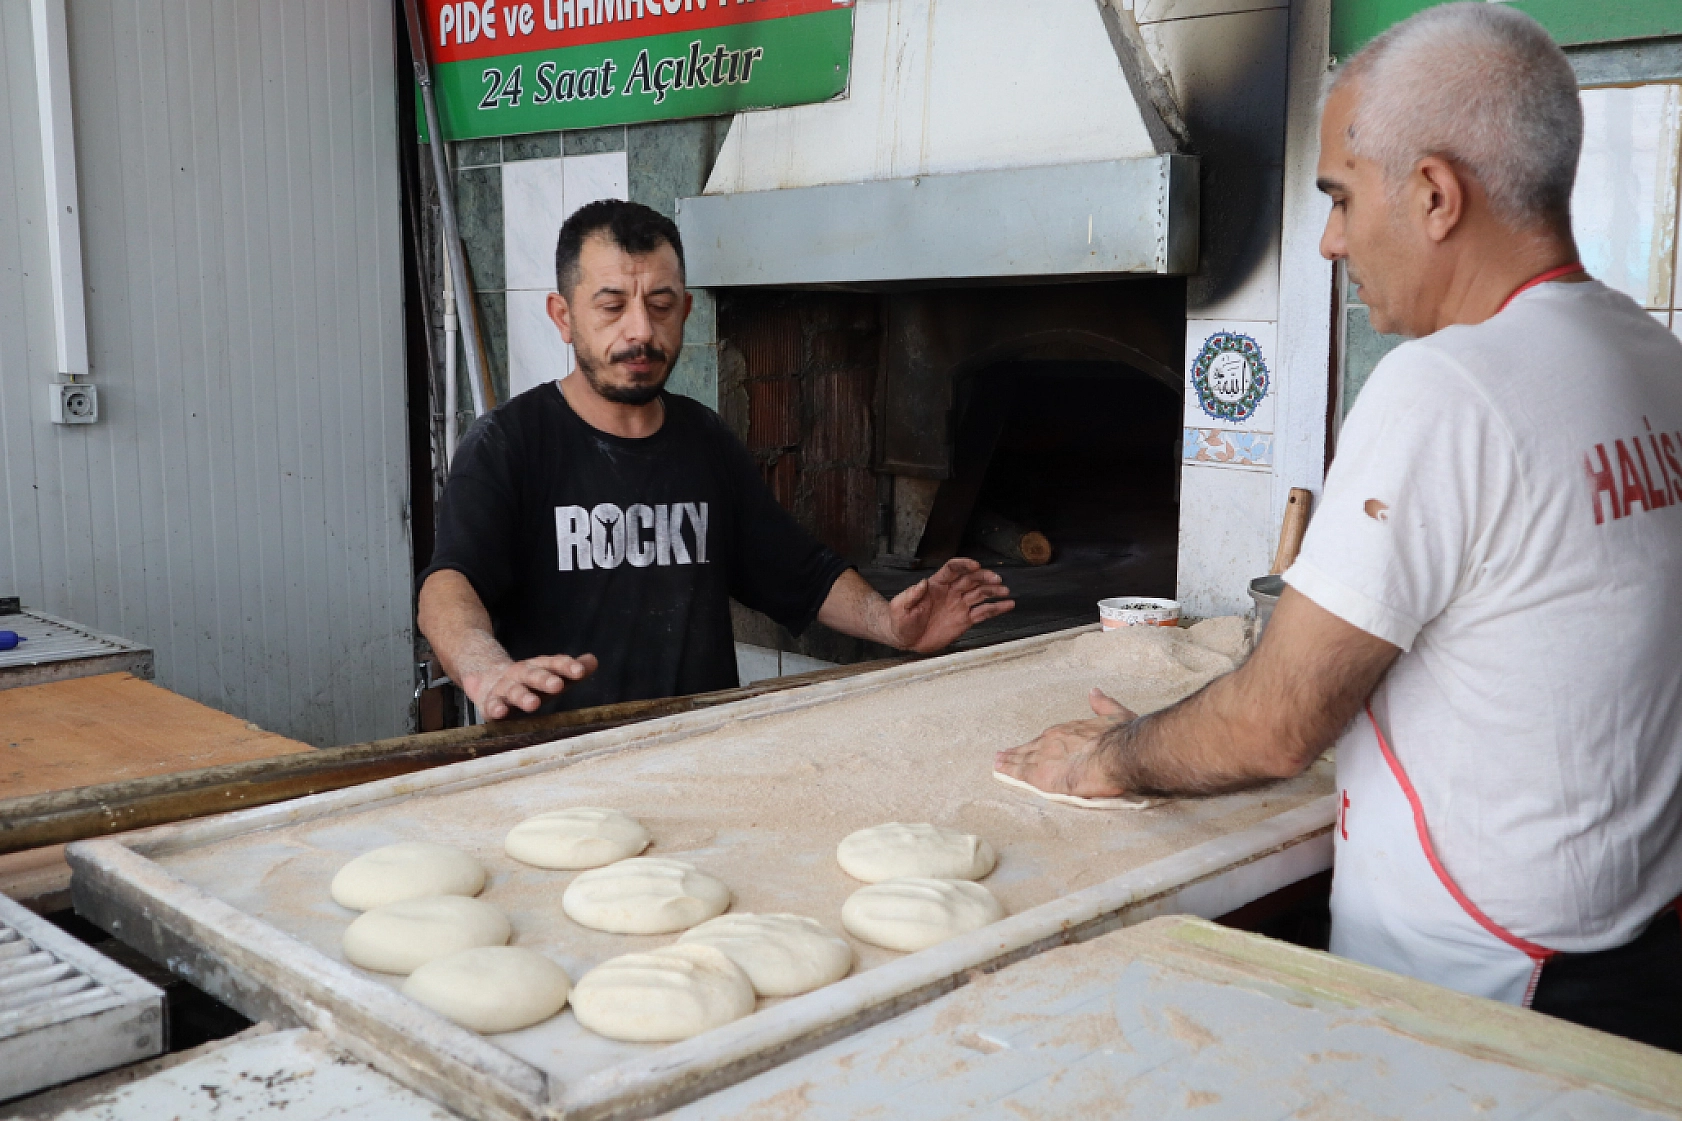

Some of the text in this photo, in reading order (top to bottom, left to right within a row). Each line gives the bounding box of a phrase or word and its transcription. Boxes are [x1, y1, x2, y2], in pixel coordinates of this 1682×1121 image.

[439, 0, 497, 46] PIDE
[503, 3, 535, 37] ve
[478, 39, 764, 110] 24 Saat Açıktır
[1582, 415, 1682, 526] HALİS
[554, 502, 709, 571] ROCKY
